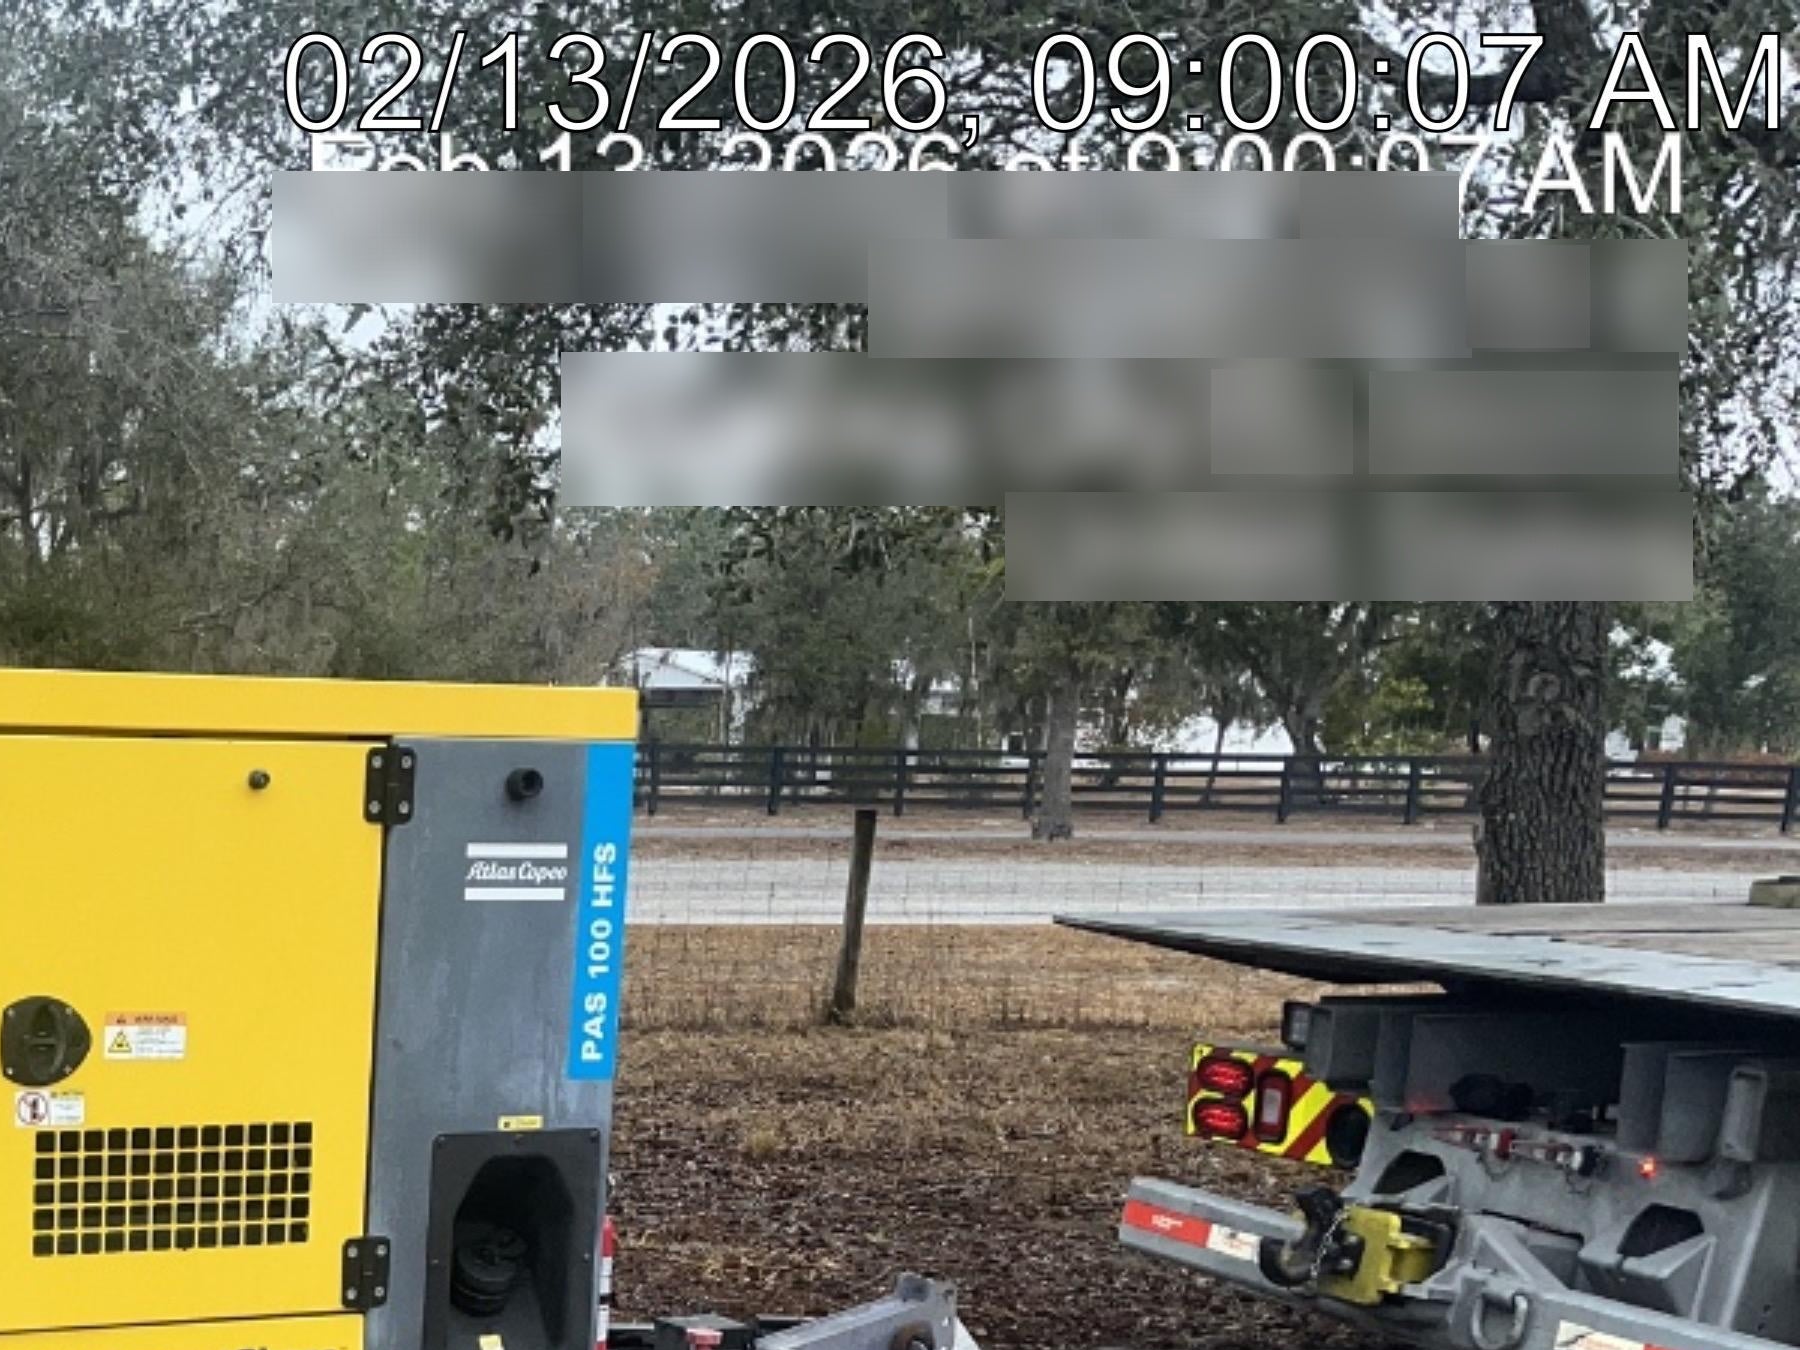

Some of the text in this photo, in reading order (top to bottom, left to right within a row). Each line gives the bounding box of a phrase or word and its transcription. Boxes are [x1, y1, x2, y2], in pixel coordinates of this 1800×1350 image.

[465, 861, 568, 885] Atlas Copco
[581, 842, 617, 1063] PAS 100 HFS
